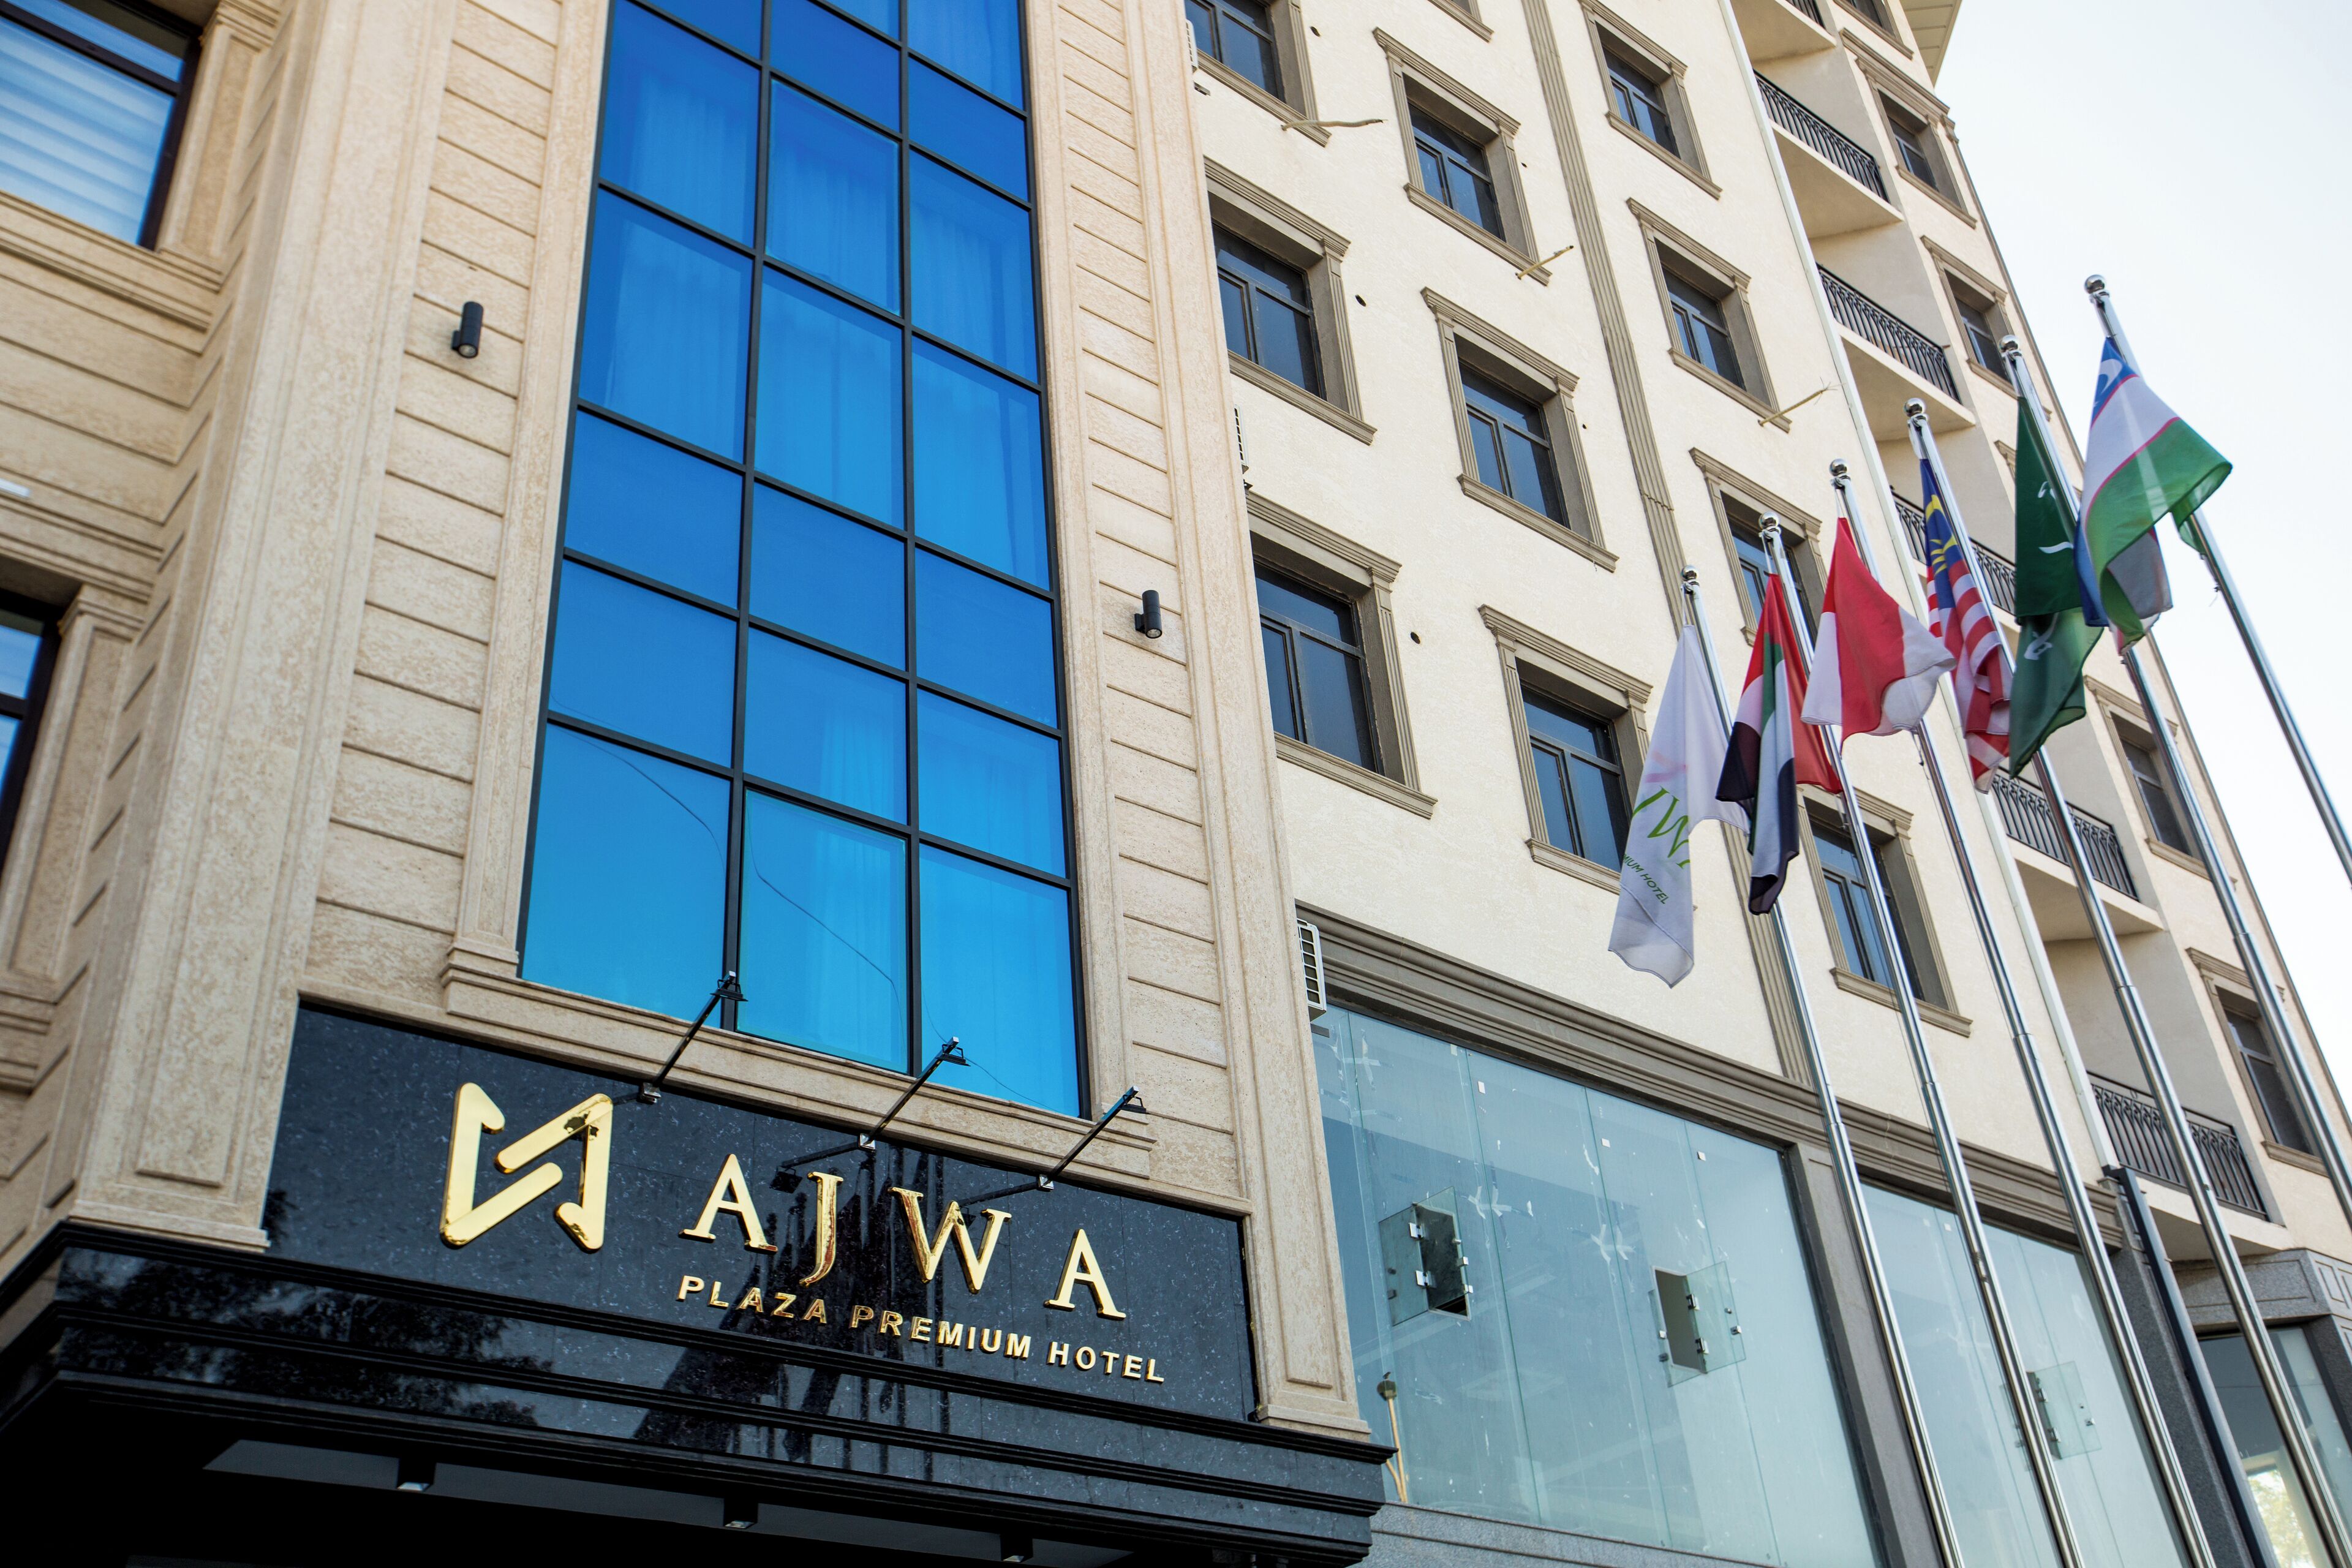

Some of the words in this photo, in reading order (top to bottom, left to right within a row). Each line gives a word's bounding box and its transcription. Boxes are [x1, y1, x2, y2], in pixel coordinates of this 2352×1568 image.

[1640, 873, 1669, 904] HOTEL
[677, 1153, 1126, 1321] AJWA
[676, 1275, 827, 1324] PLAZA
[849, 1305, 1031, 1360] PREMIUM
[1047, 1341, 1164, 1383] HOTEL
